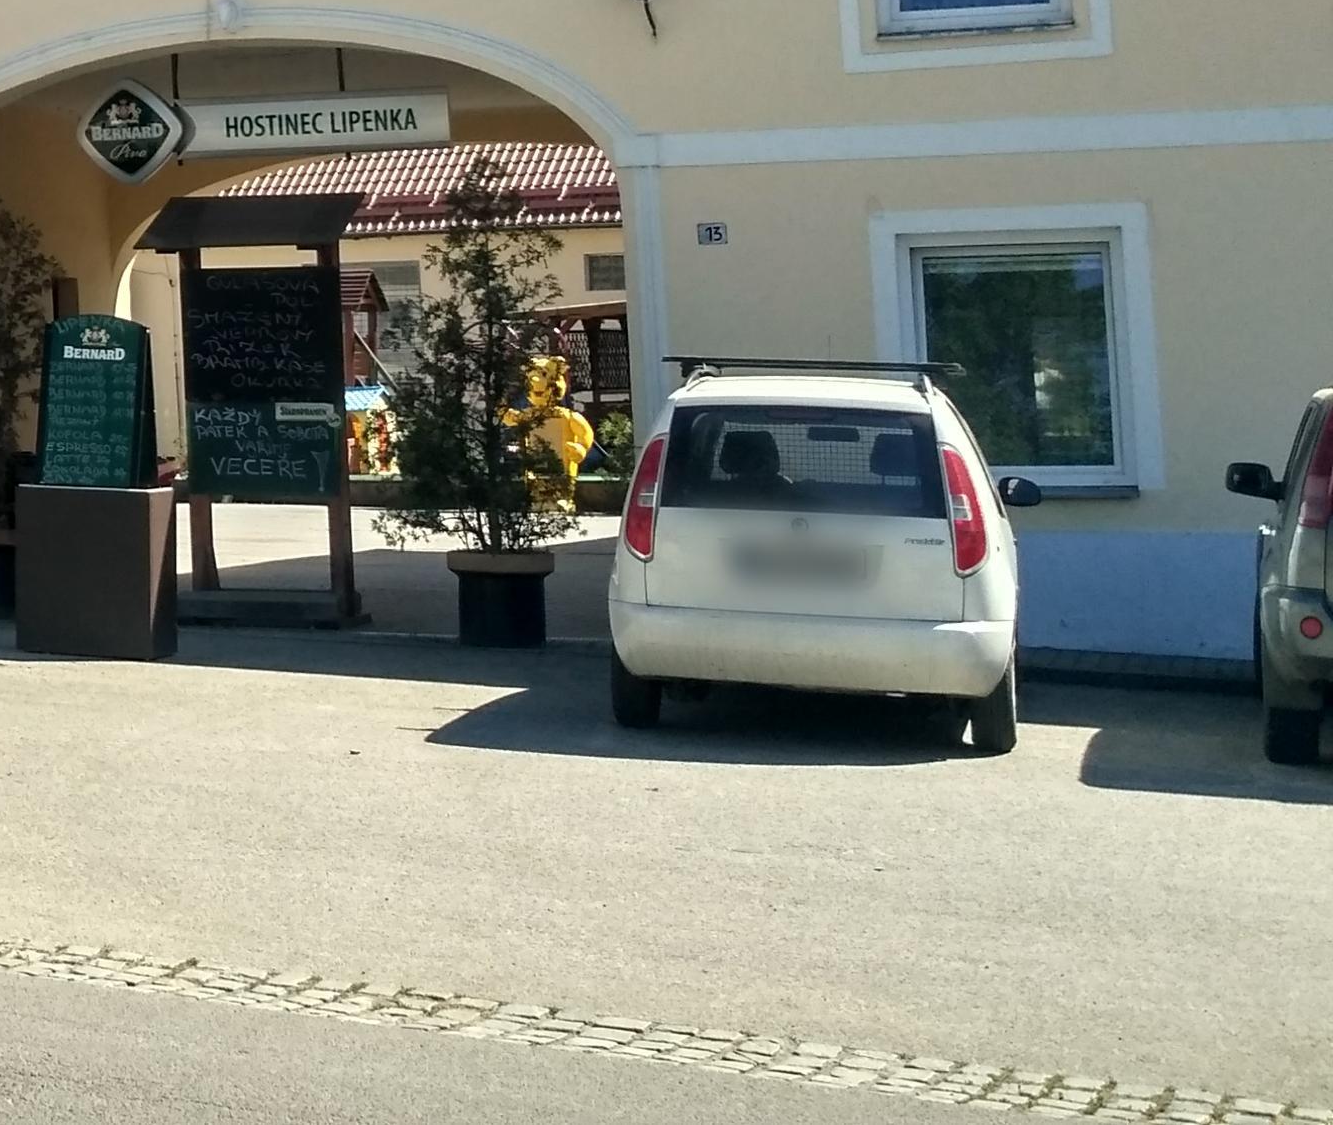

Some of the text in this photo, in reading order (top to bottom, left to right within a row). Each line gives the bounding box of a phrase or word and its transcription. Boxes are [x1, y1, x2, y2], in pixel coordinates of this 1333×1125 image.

[225, 107, 418, 138] HOSTINEC LIPENKA
[90, 123, 164, 142] BERNARD
[705, 226, 723, 242] 13
[63, 345, 126, 361] BERNARD
[194, 407, 261, 426] KAŽDÝ
[45, 441, 110, 455] ESPRESSO
